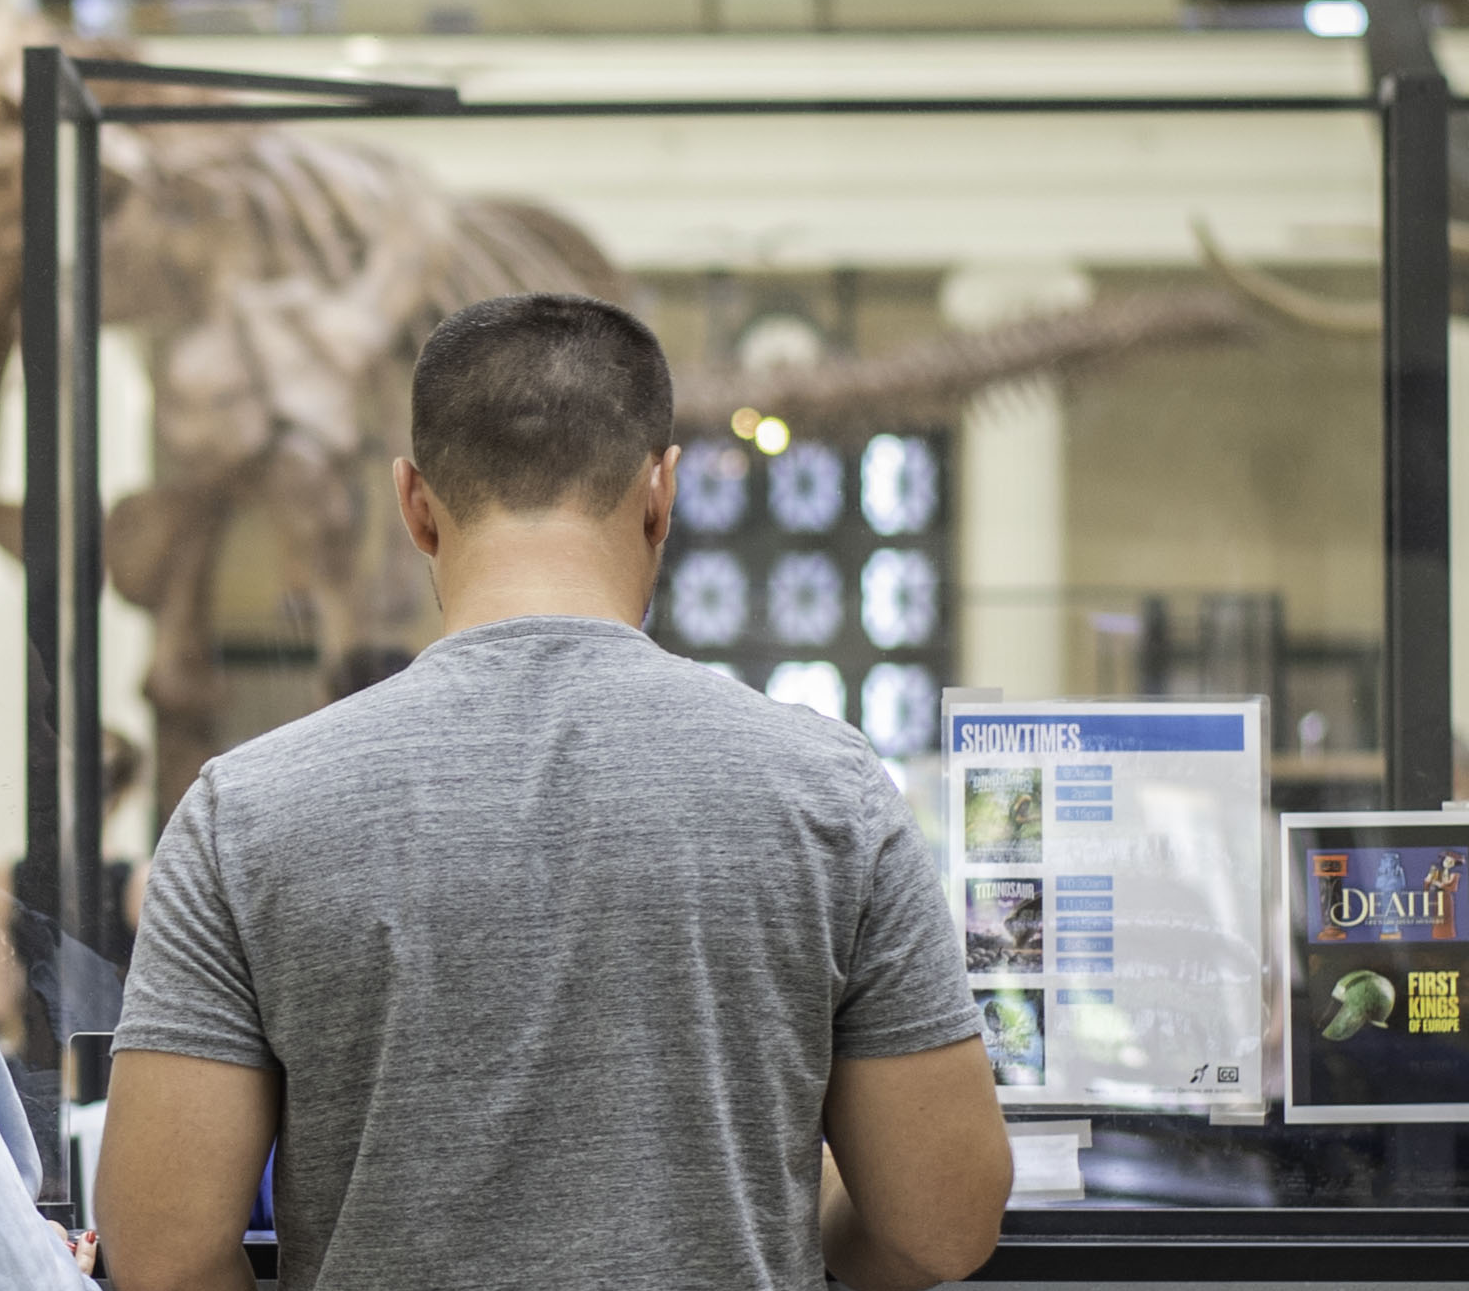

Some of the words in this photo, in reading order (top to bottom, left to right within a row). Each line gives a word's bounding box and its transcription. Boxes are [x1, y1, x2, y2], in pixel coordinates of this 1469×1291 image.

[962, 723, 1080, 753] SHOWTIMES
[975, 882, 1034, 900] TITANOSAUR
[1330, 888, 1444, 927] DEATH
[1408, 971, 1459, 996] FIRST
[1408, 996, 1459, 1019] KINGS
[1409, 1019, 1421, 1033] OF
[1423, 1018, 1460, 1033] EUROPE
